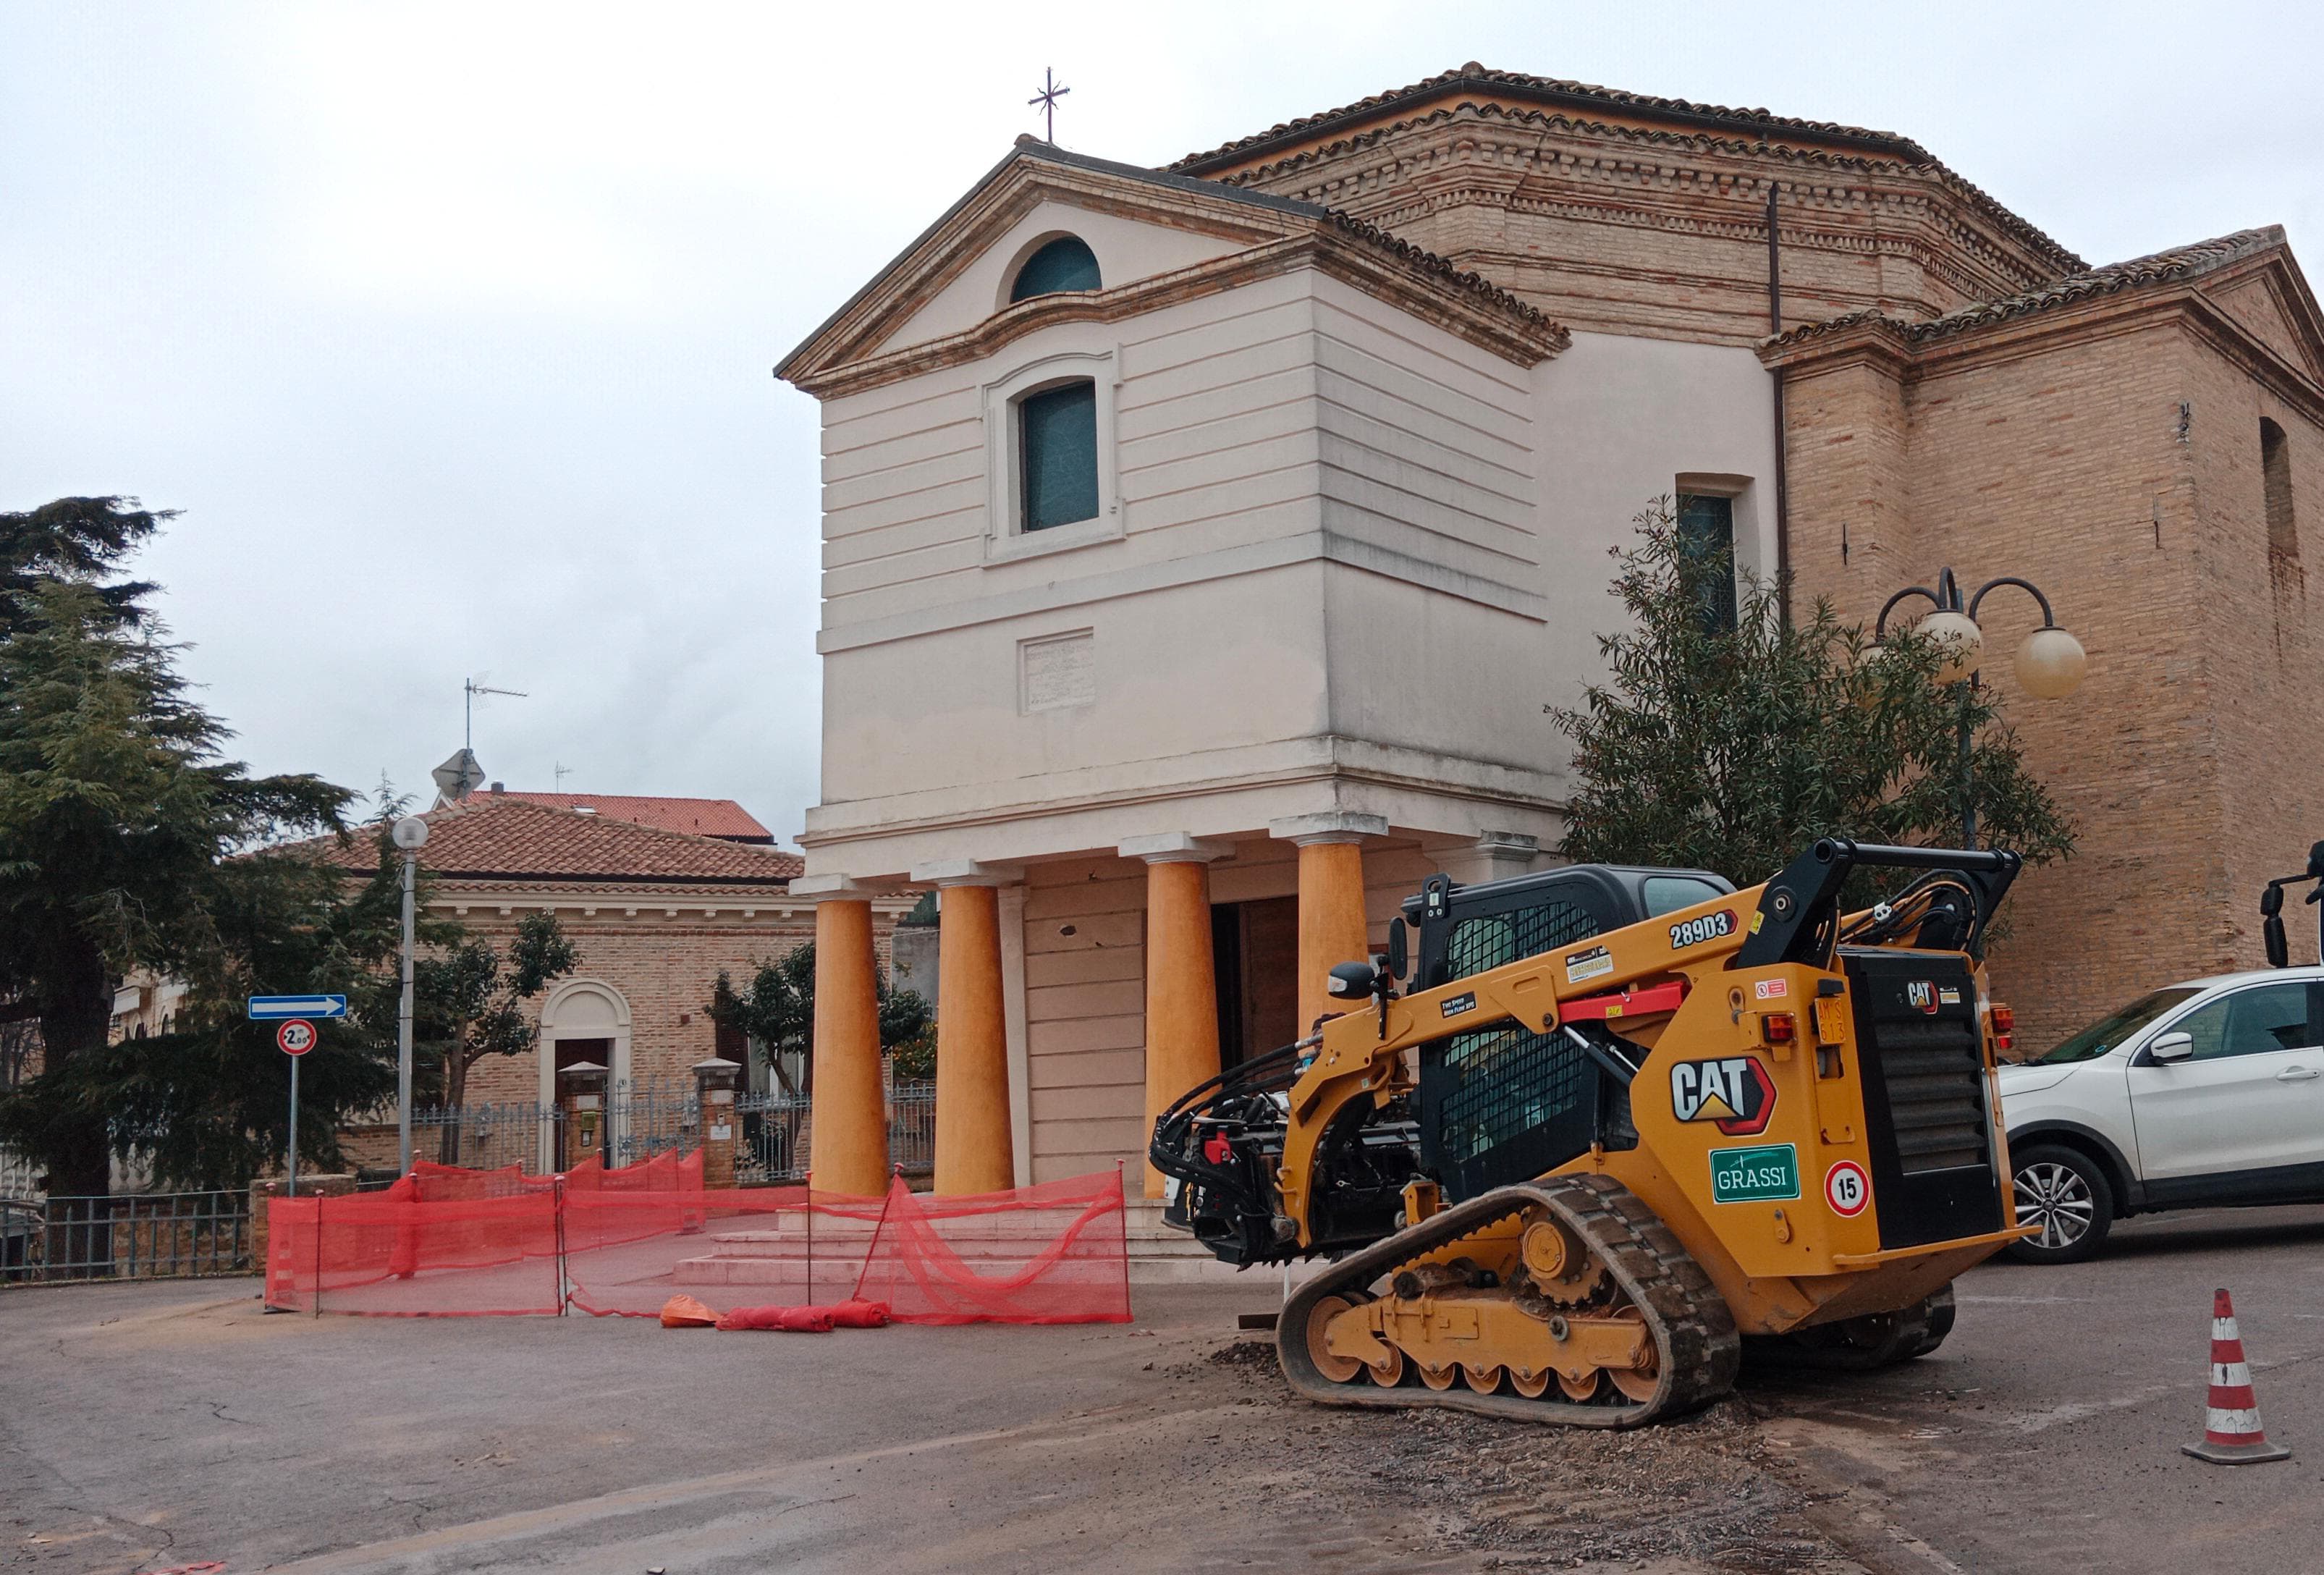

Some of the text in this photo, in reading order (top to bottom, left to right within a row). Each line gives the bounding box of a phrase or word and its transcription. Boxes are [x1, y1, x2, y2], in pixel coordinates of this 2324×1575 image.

[1670, 912, 1728, 949] 289D3
[1908, 982, 1930, 1007] CAT
[1820, 1023, 1845, 1041] 613
[1671, 1059, 1748, 1120] CAT
[1717, 1167, 1786, 1190] GRASSI
[1838, 1177, 1857, 1200] 15
